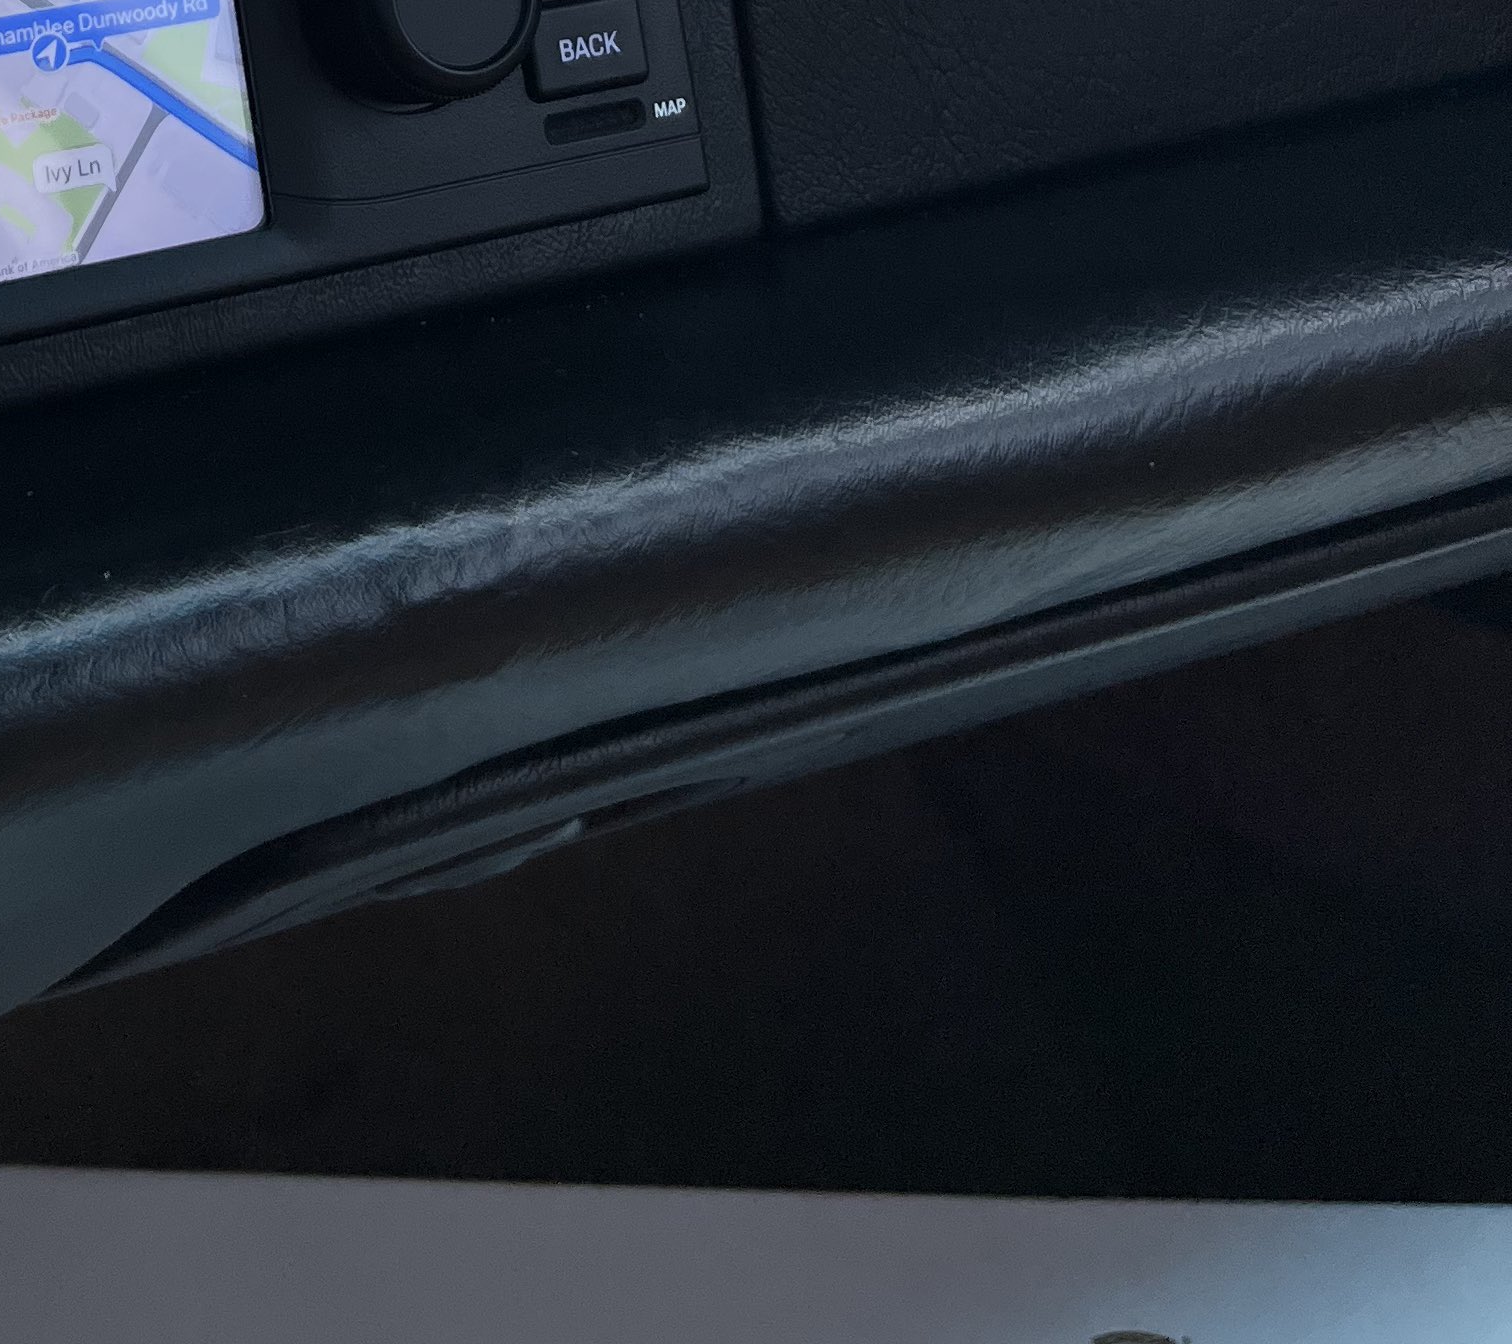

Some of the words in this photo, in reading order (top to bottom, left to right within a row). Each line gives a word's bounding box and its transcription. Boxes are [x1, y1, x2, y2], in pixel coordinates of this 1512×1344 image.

[558, 30, 621, 63] BACK
[10, 106, 58, 123] Package
[653, 97, 686, 118] MAP
[44, 165, 72, 184] Ivy
[77, 159, 101, 177] Ln
[31, 252, 77, 271] America
